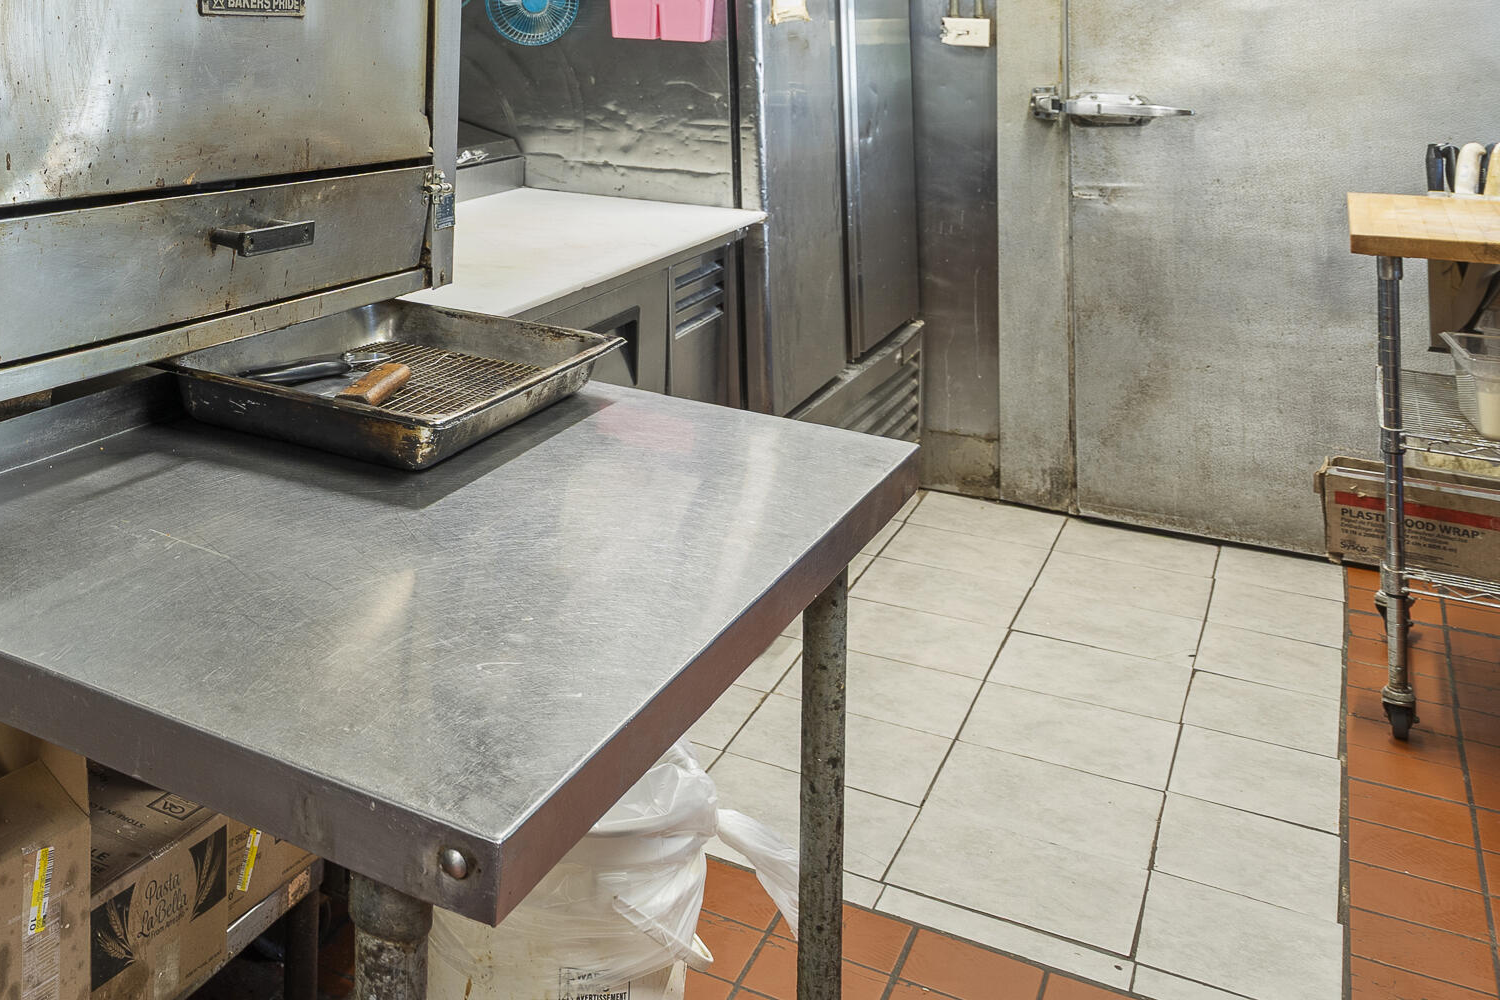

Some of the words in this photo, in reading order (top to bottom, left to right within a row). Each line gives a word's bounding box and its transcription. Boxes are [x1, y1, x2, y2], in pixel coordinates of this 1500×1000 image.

[1341, 508, 1386, 523] PLASTI
[1405, 518, 1436, 532] OOD
[145, 872, 181, 905] Pasta
[137, 910, 154, 938] La
[155, 888, 188, 923] Bella
